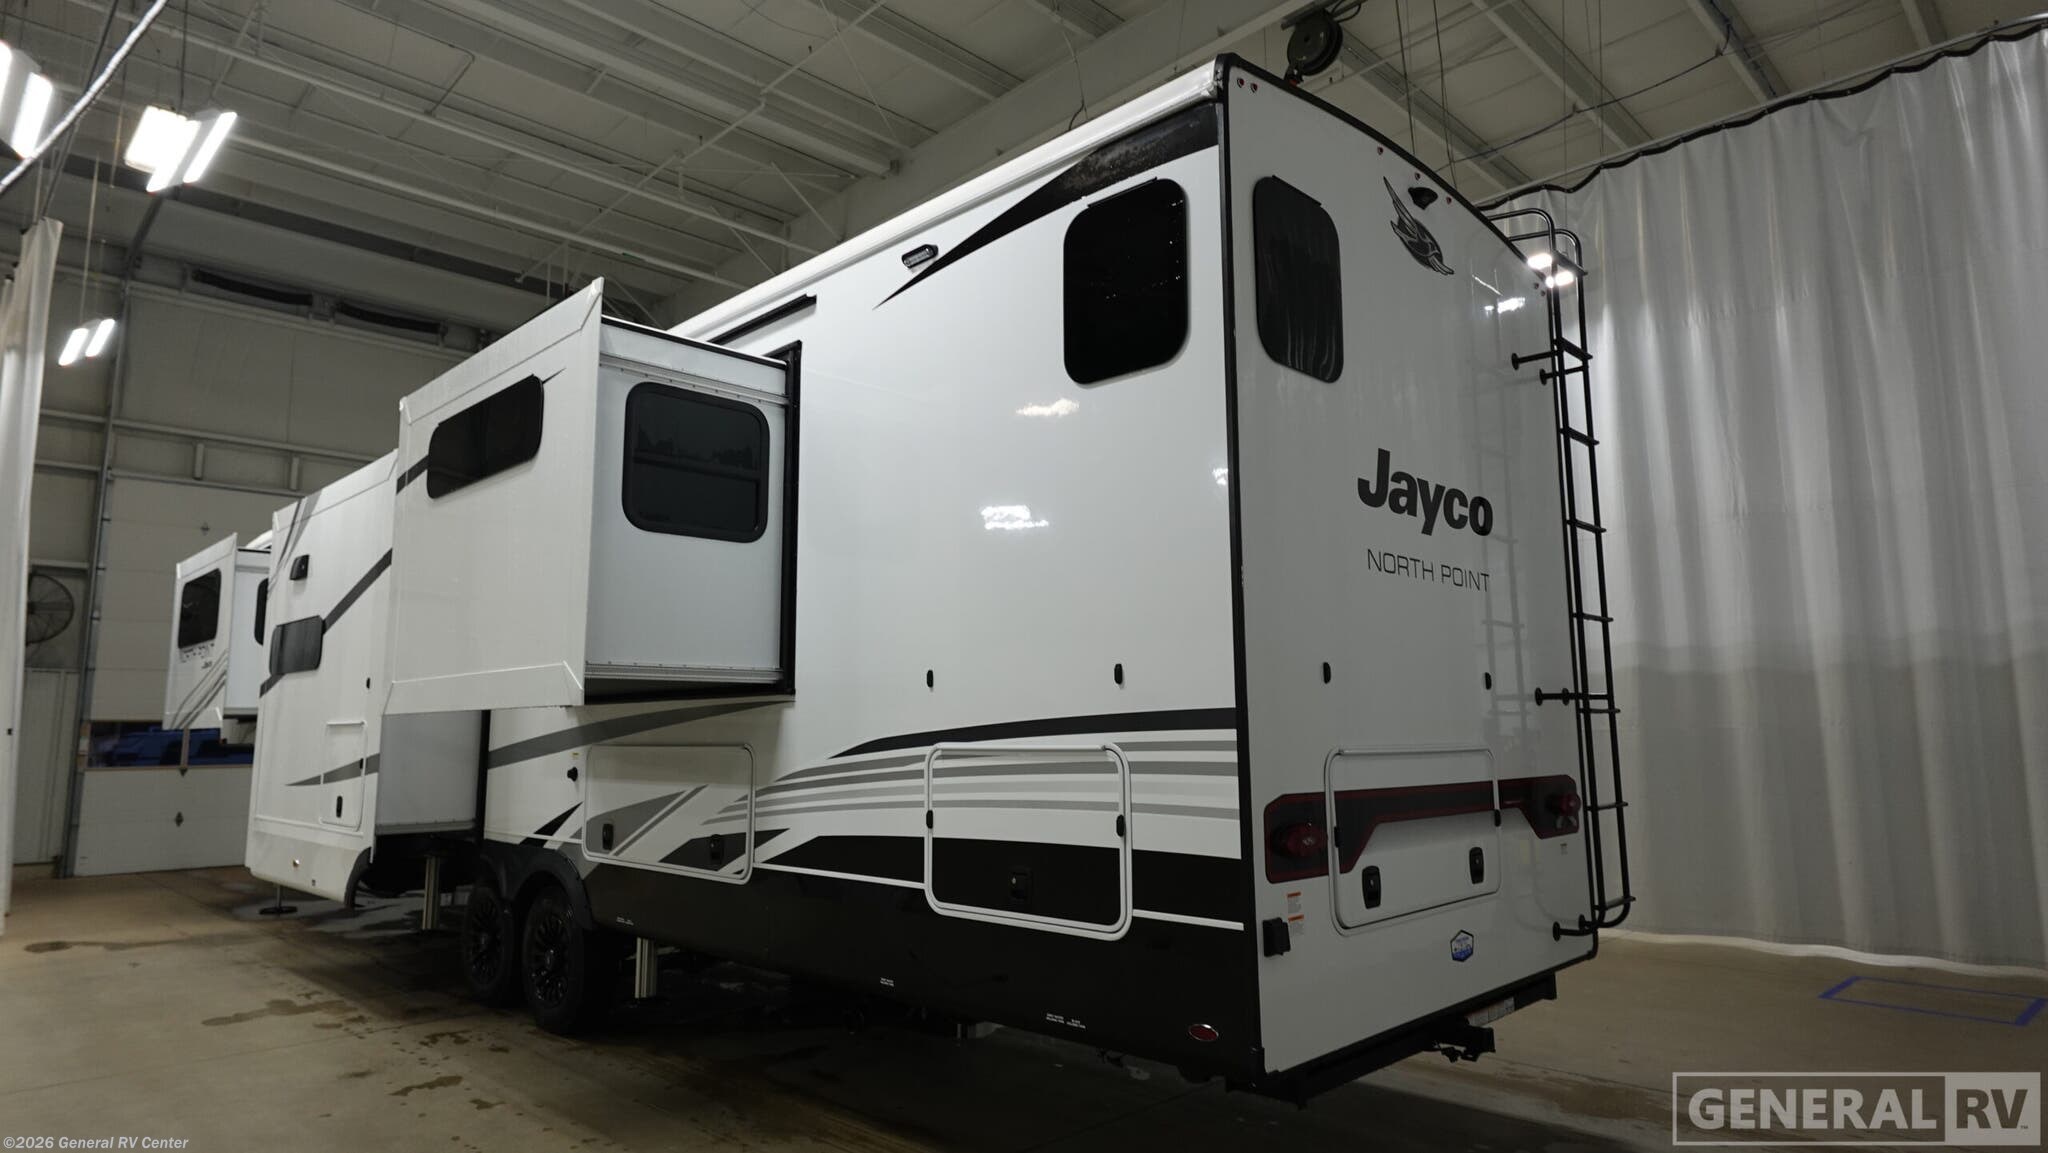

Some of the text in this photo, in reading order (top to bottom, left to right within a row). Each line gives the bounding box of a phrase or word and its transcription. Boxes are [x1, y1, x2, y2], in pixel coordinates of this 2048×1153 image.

[1357, 448, 1493, 536] Jayco
[1367, 549, 1490, 592] NORTH POINT
